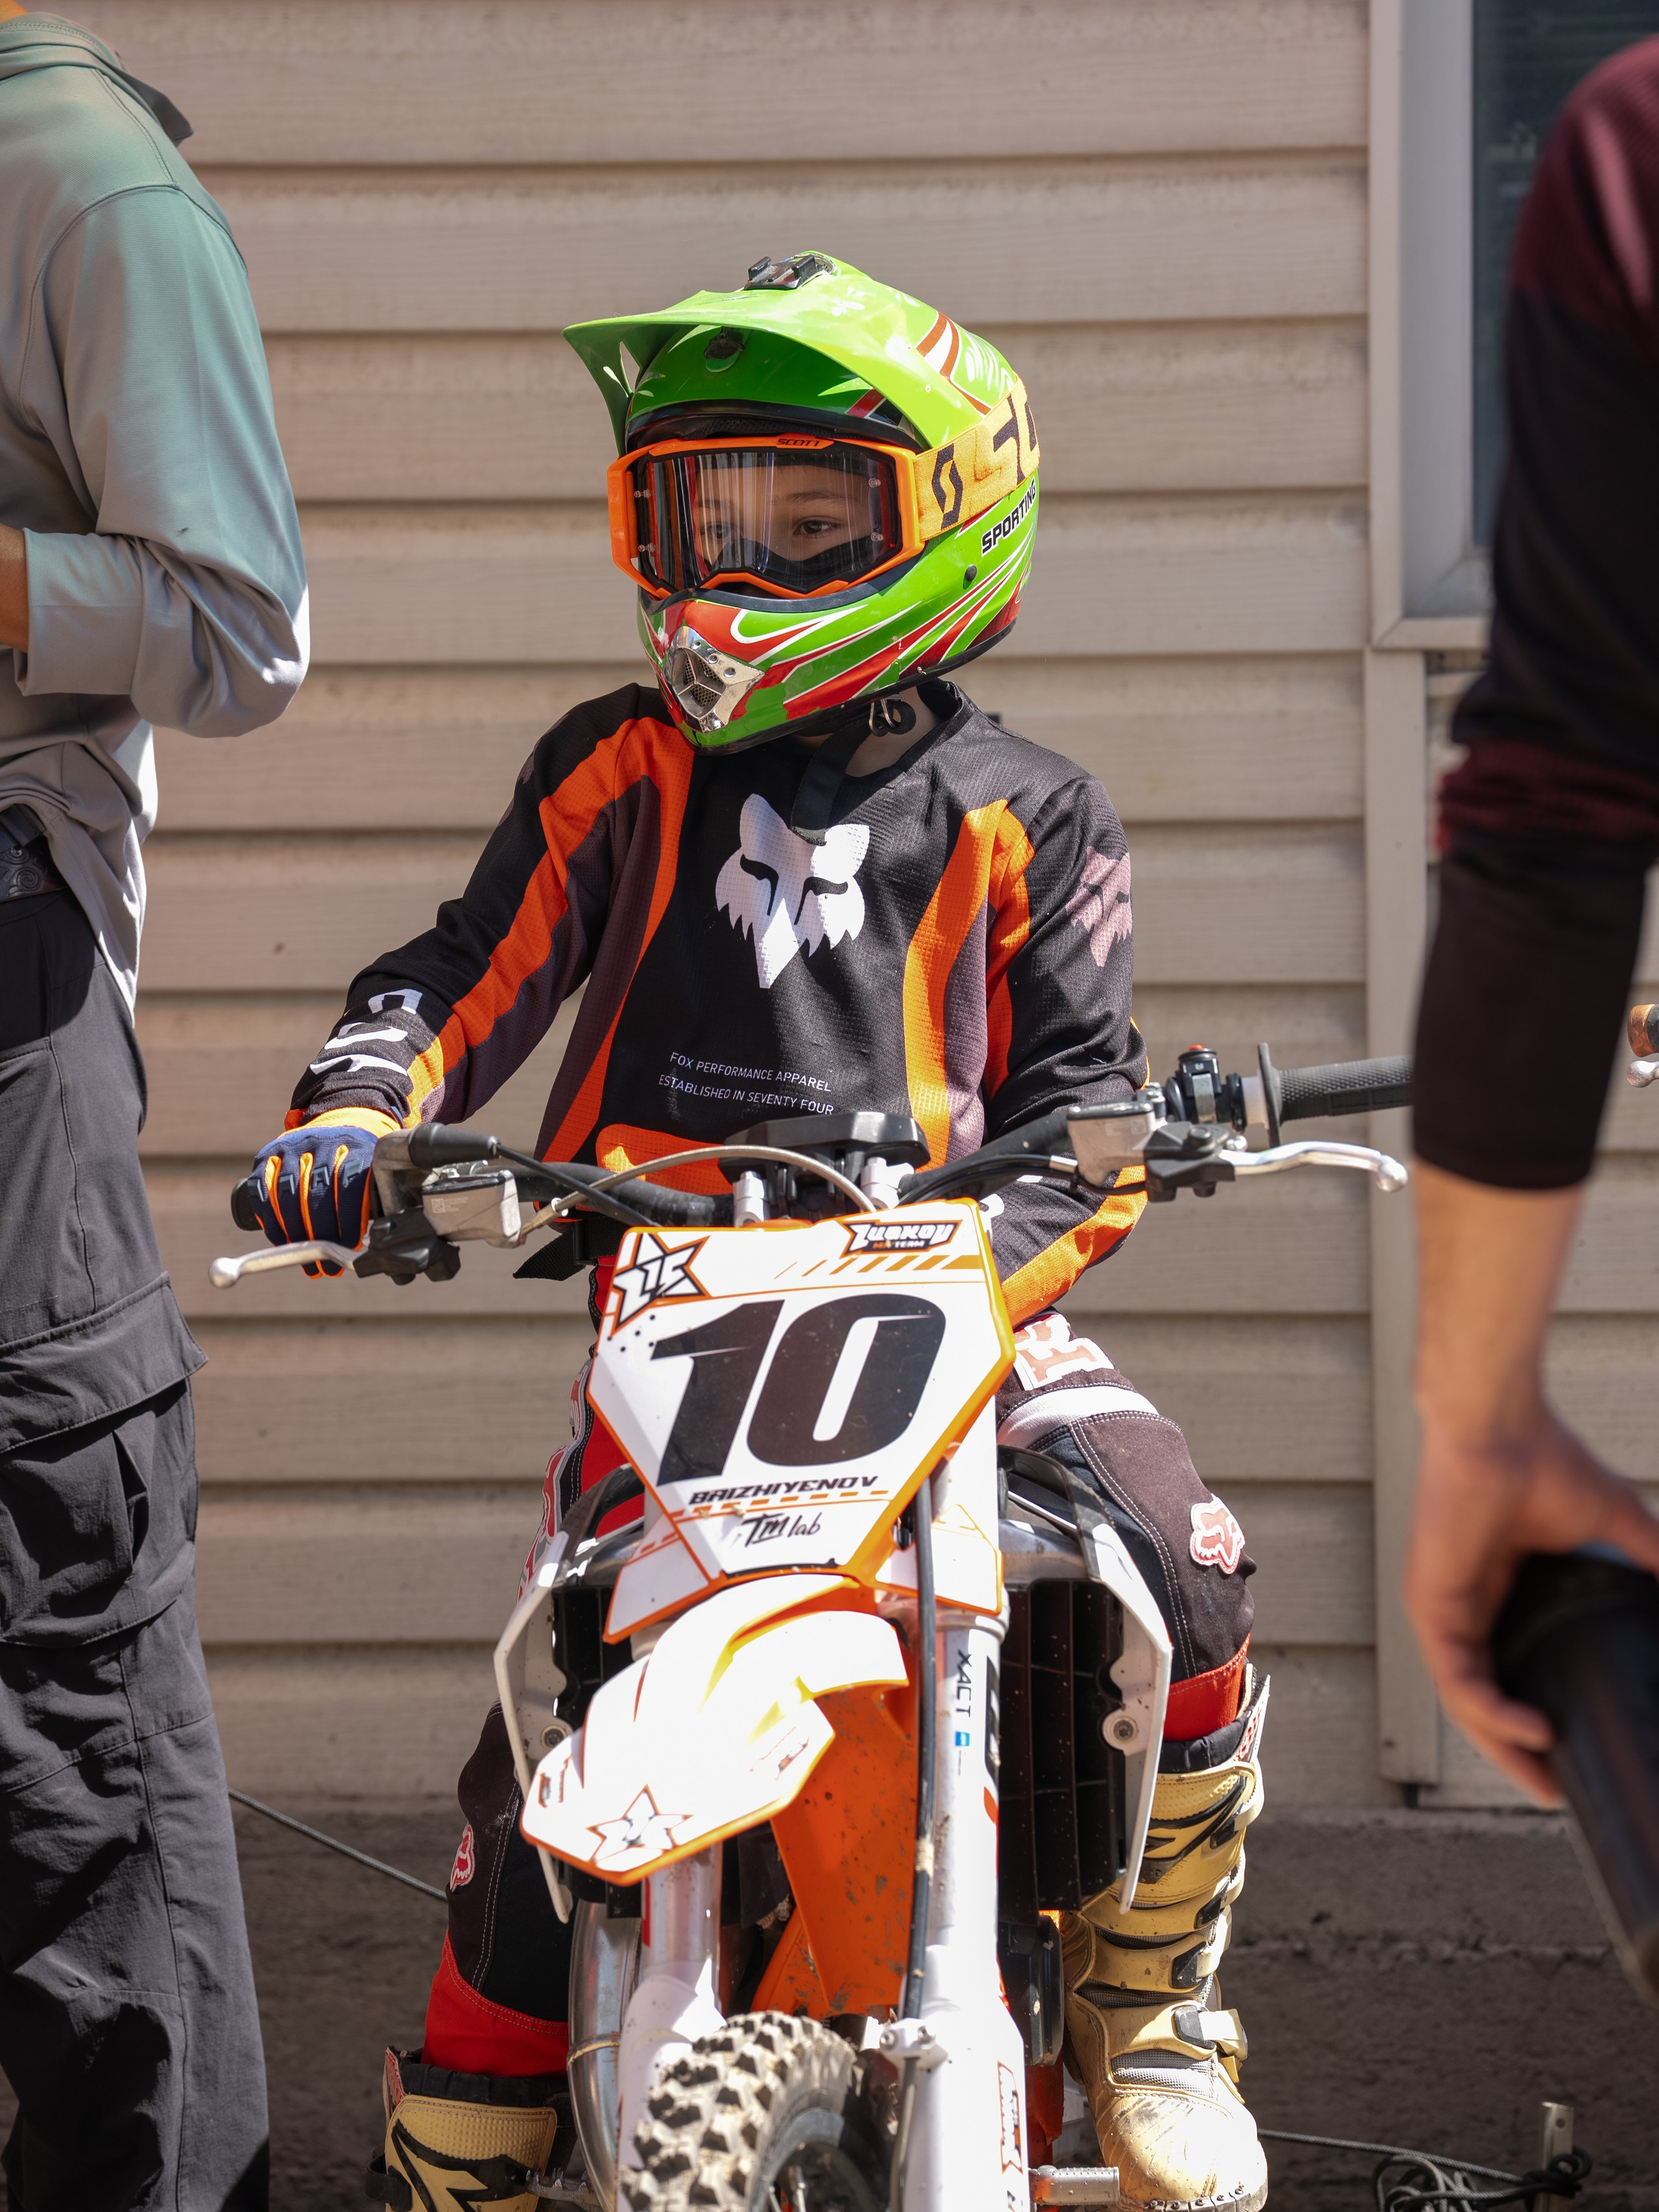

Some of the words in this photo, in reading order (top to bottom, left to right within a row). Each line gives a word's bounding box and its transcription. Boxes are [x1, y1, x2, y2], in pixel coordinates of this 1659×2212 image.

[776, 439, 820, 447] SCOTT
[982, 478, 1036, 555] SPORTING
[669, 1052, 694, 1069] FOX
[696, 1061, 774, 1080] PERFORMANCE
[775, 1071, 831, 1092] APPAREL
[658, 1074, 731, 1099] ESTABLISHED
[732, 1089, 745, 1100] IN
[747, 1092, 798, 1108] SEVENTY
[800, 1099, 834, 1115] FOUR
[894, 1240, 925, 1249] TEAM
[649, 1292, 946, 1487] 10
[787, 1511, 822, 1538] lab
[955, 1648, 973, 1718] XACT
